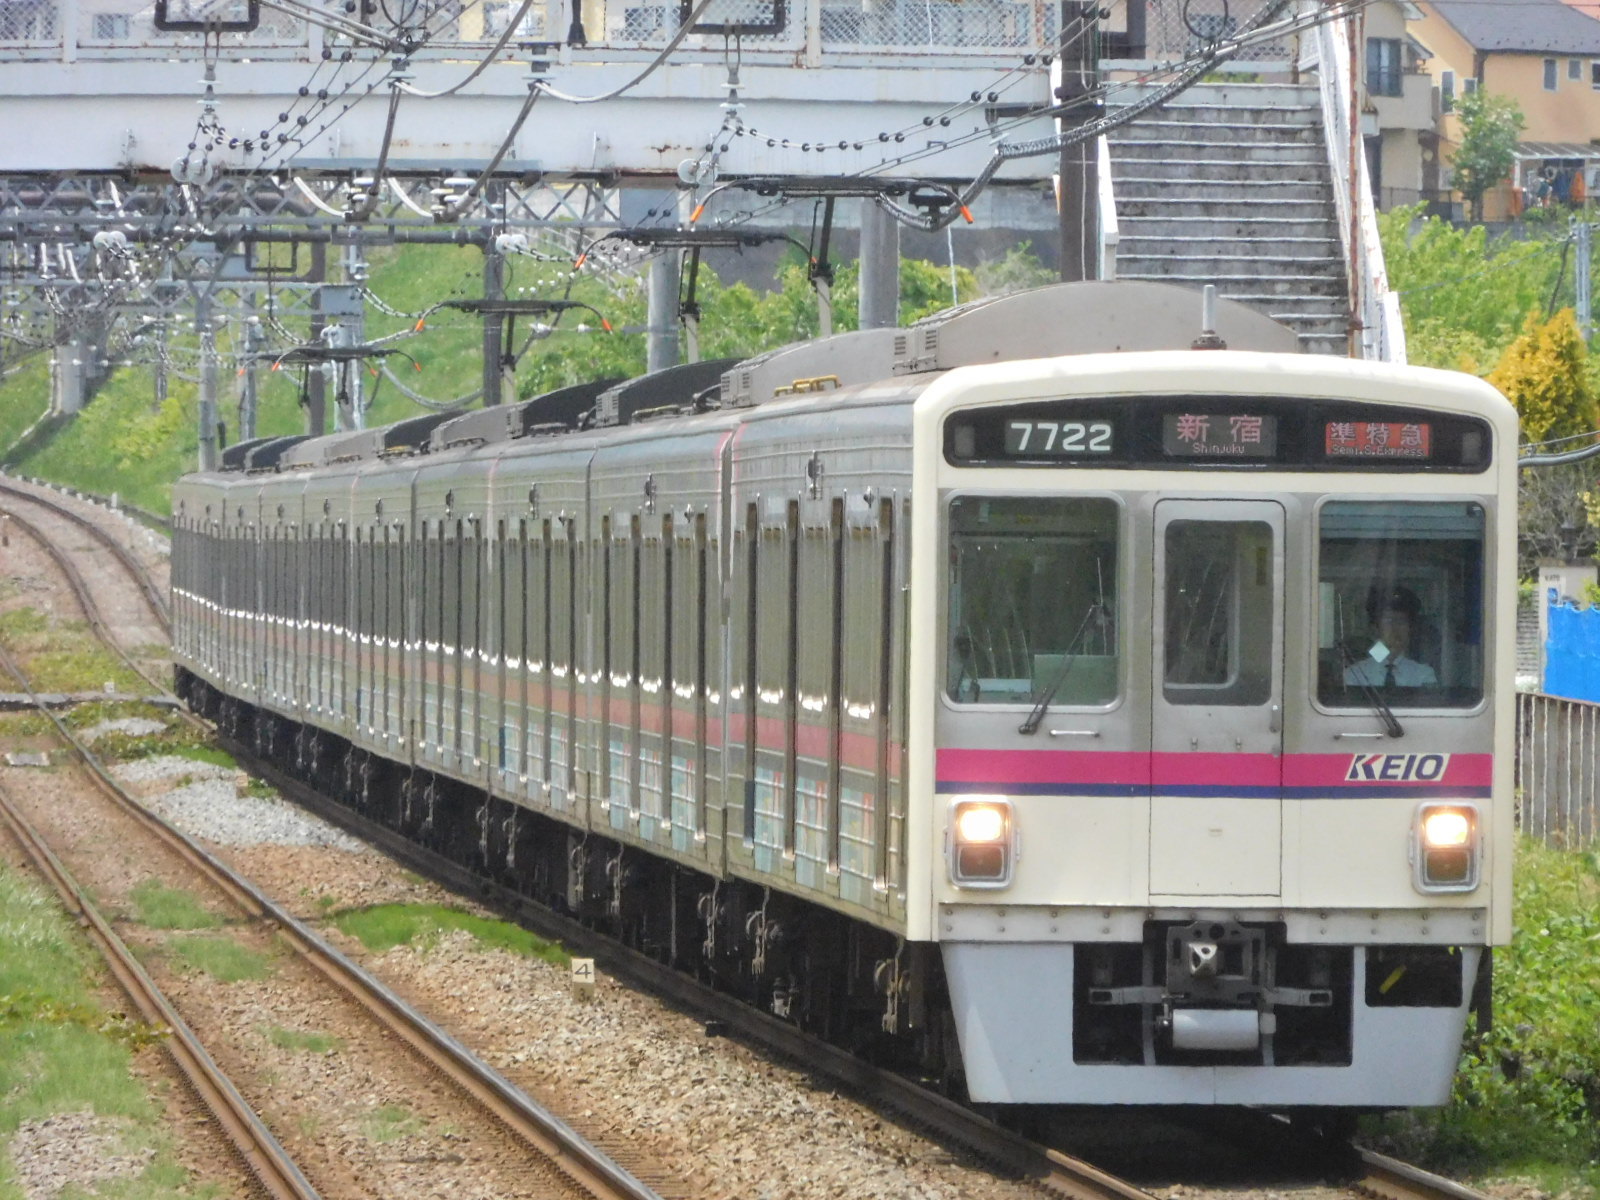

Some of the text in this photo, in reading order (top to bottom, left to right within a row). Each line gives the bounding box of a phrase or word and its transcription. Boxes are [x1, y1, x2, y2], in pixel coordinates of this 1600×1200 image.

[1011, 423, 1111, 451] 7722
[1177, 413, 1262, 443] 新宿
[1331, 422, 1423, 446] 準特急
[1193, 442, 1245, 454] Shinjuku
[1349, 754, 1444, 780] KEIO
[574, 963, 592, 979] 4
